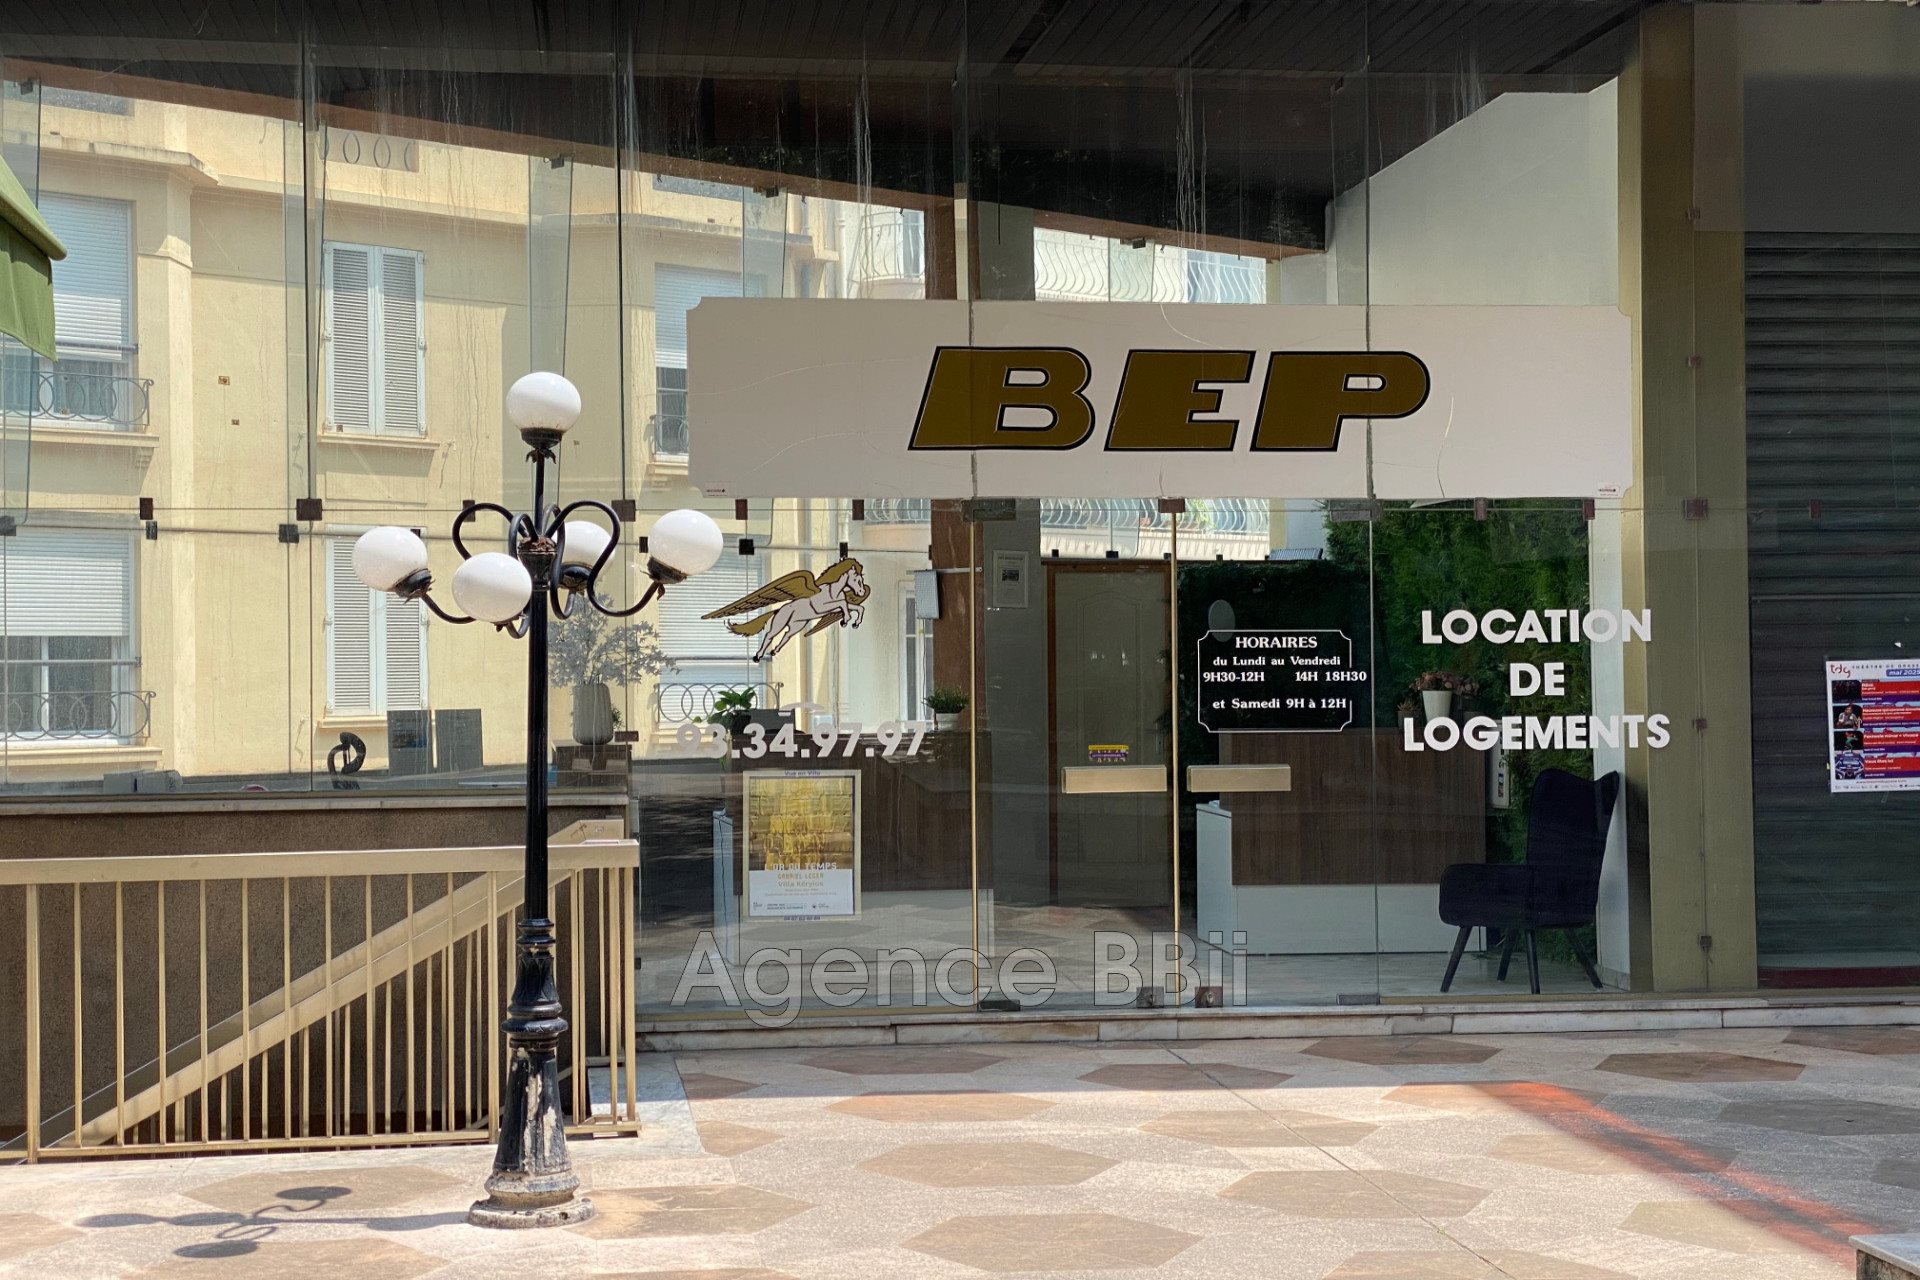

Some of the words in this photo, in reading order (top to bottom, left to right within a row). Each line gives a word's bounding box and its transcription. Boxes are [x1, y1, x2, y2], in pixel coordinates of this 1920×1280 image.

[907, 345, 1431, 451] BEP
[1421, 608, 1652, 644] LOCATION
[1235, 636, 1318, 649] HORAIRES
[1213, 656, 1228, 666] du
[1232, 656, 1266, 666] Lundi
[1290, 656, 1341, 666] Vendredi
[1203, 671, 1265, 682] 9H30-12H
[1295, 671, 1318, 682] 14H
[1325, 671, 1367, 682] 18H30
[1509, 662, 1565, 697] DE
[1212, 700, 1226, 709] et
[1231, 698, 1280, 709] Samedi
[1286, 698, 1305, 709] 9H
[1308, 698, 1316, 709] à
[1320, 698, 1347, 709] 12H
[676, 721, 927, 759] 93.34.97.97
[1403, 713, 1671, 752] LOGEMENTS
[805, 862, 837, 870] TEMPS
